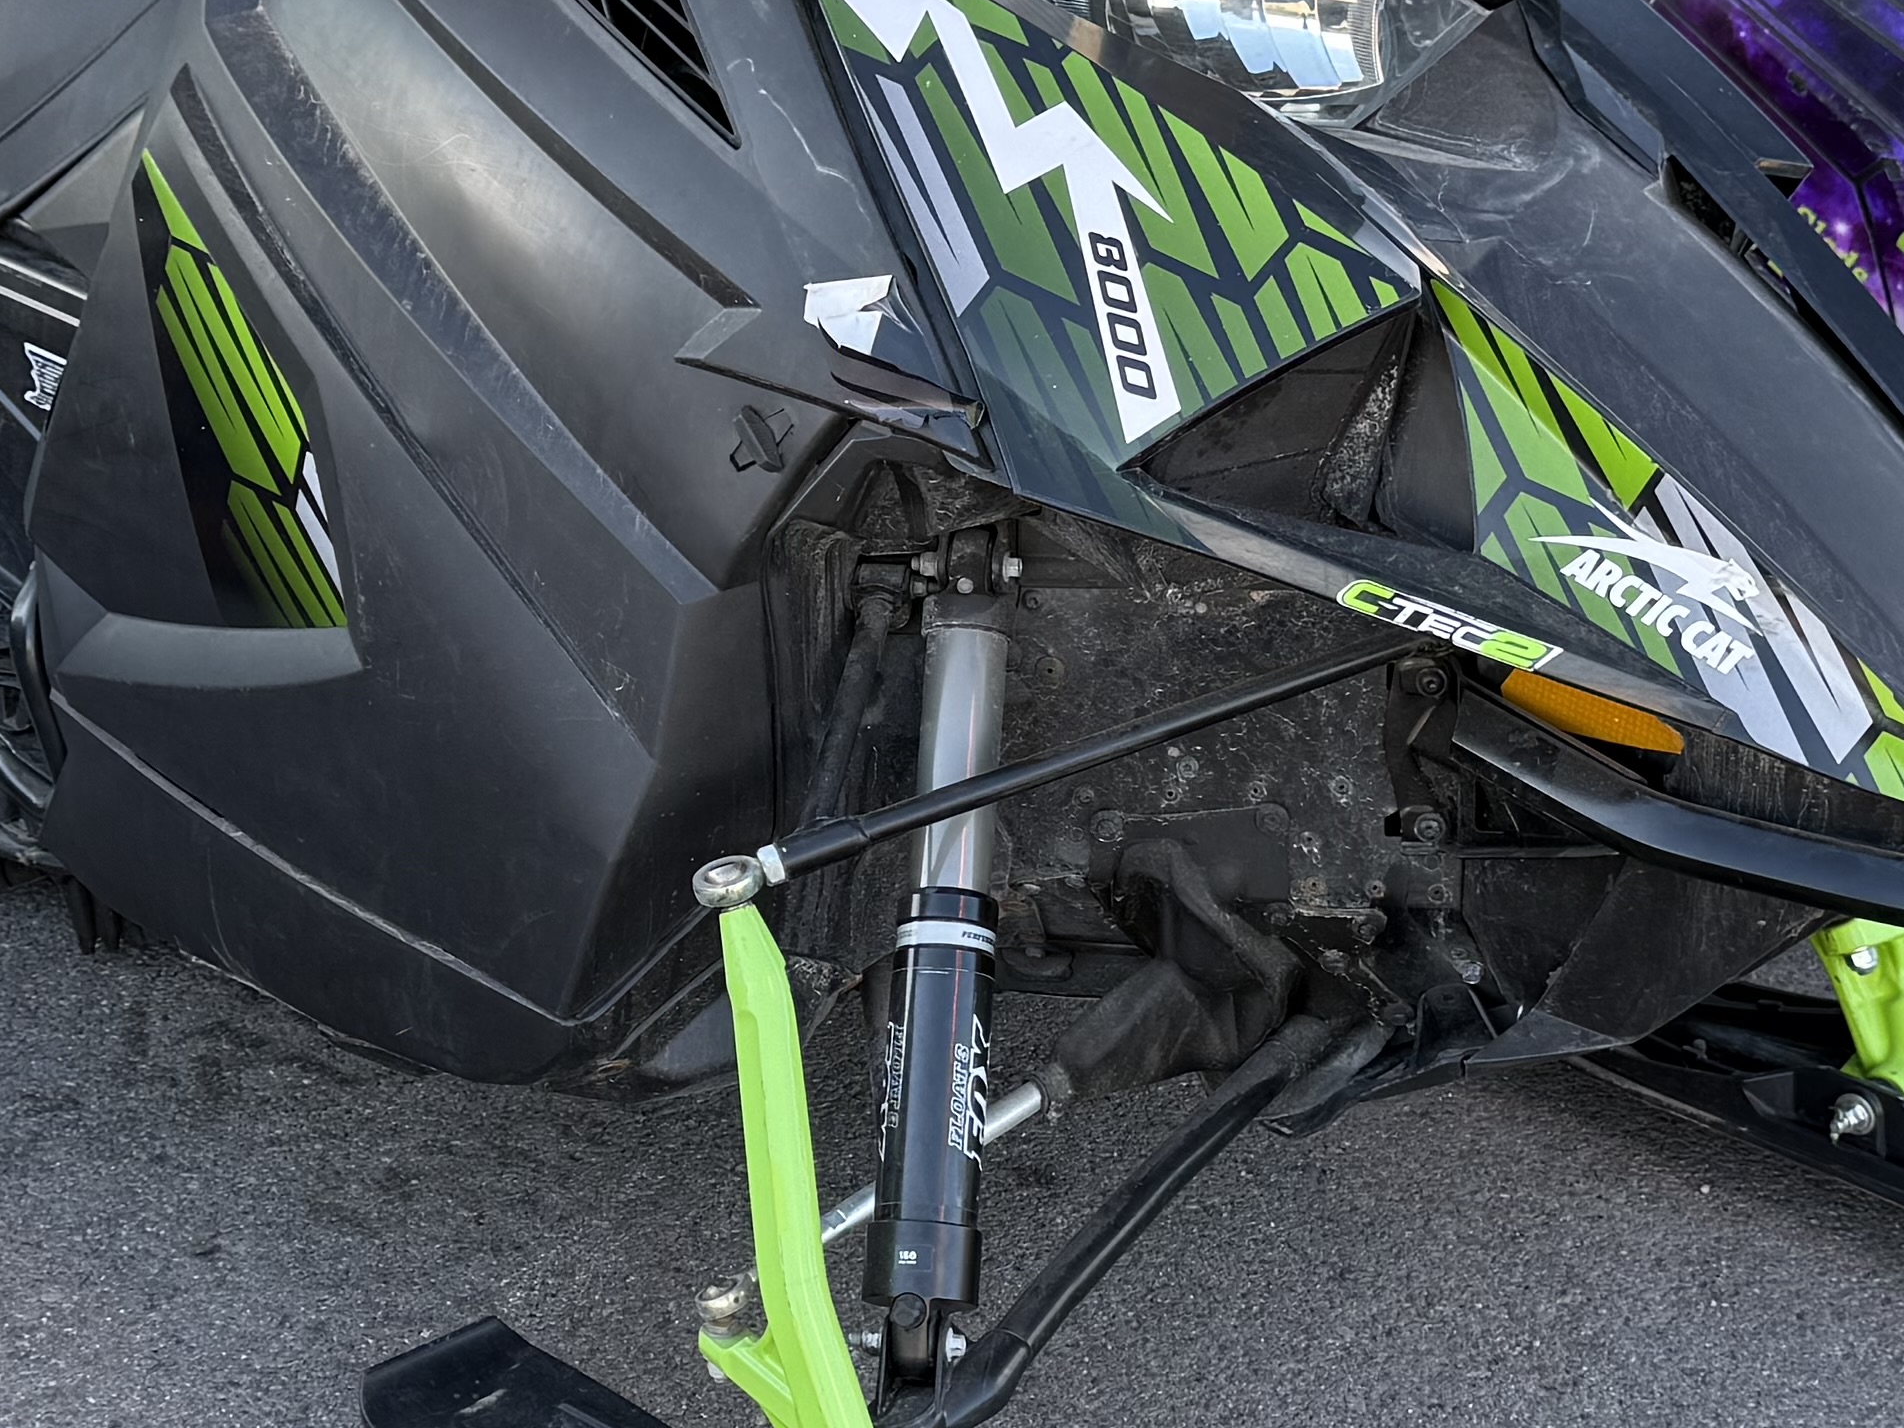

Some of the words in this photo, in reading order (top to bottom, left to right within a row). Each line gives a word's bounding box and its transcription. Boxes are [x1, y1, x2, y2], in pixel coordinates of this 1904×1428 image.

[1088, 231, 1158, 401] 8000
[1559, 548, 1691, 637] ARCTIC
[1680, 620, 1756, 675] CAT
[955, 1043, 969, 1059] 3
[948, 1061, 969, 1151] FLOAT
